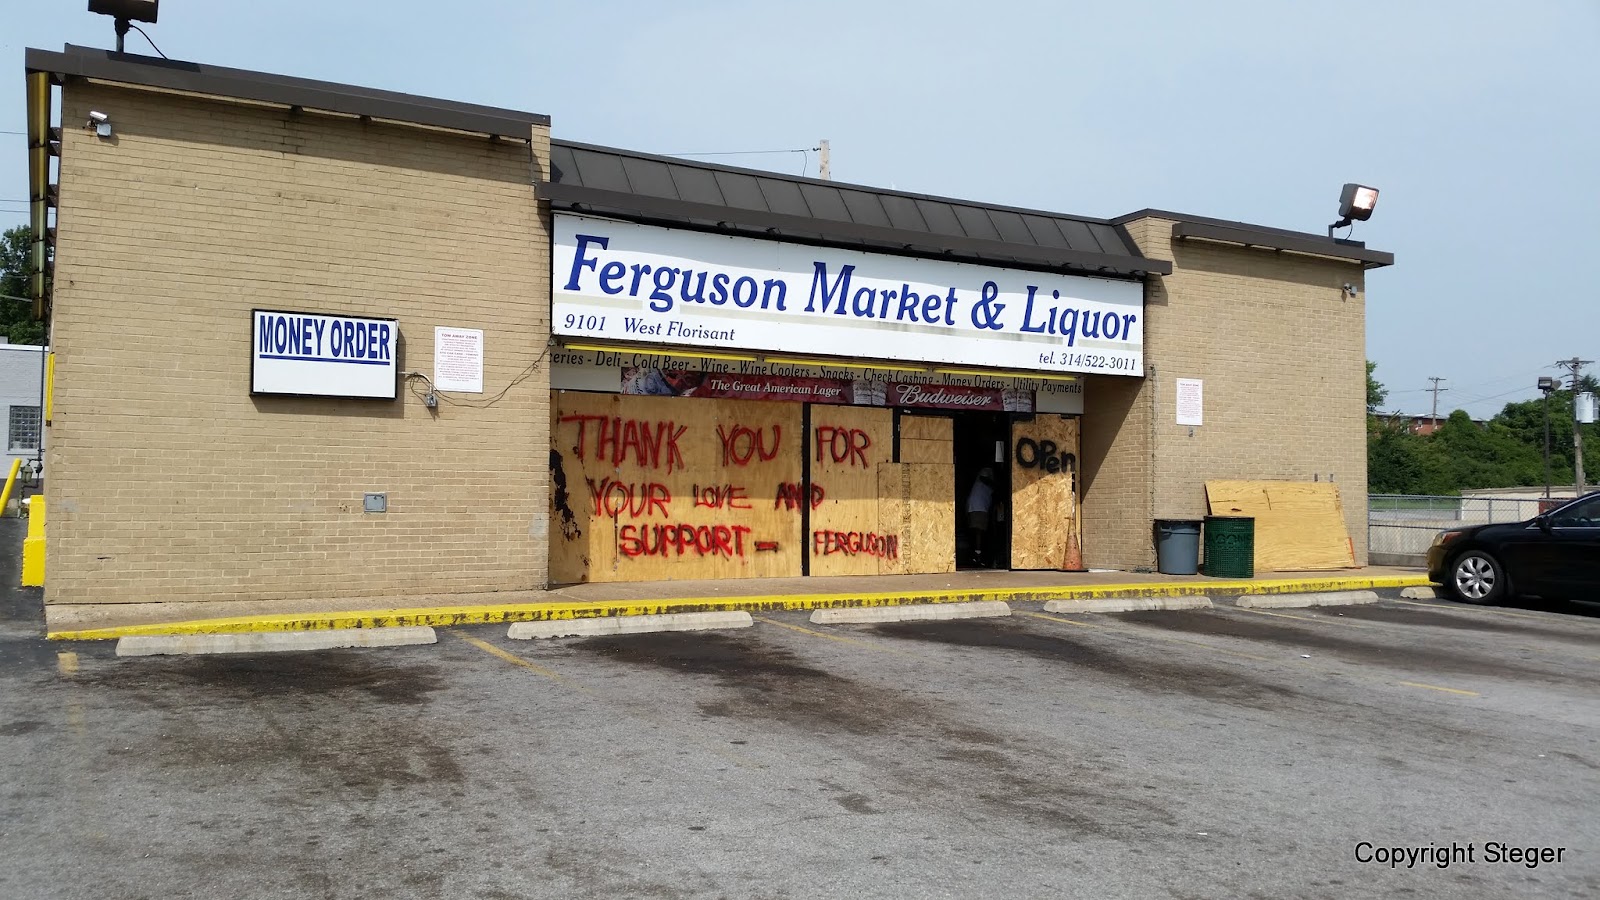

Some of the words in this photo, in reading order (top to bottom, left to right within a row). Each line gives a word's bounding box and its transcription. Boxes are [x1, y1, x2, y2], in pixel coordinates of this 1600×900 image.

[564, 234, 786, 312] Ferguson
[804, 261, 957, 326] Market
[971, 281, 1005, 331] &
[1020, 285, 1137, 347] Liquor
[260, 315, 326, 356] MONEY
[330, 320, 390, 359] ORDER
[564, 314, 606, 331] 9101
[624, 317, 661, 336] West
[666, 321, 735, 341] Florisant
[595, 350, 621, 367] Deli
[633, 353, 660, 370] Cold
[662, 355, 690, 371] Beer
[700, 357, 729, 373] Wine
[740, 359, 767, 375] Wine
[770, 362, 810, 377] Coolers
[820, 365, 854, 380] Snacks
[863, 367, 892, 382] Check
[942, 373, 972, 387] Money
[974, 375, 1005, 389] Orders
[1013, 377, 1039, 392] Utility
[1041, 379, 1081, 394] Payments
[1039, 352, 1056, 365] tel.
[1059, 353, 1136, 371] 314/522-3011
[711, 379, 730, 391] The
[732, 381, 761, 393] Great
[763, 383, 811, 395] American
[813, 385, 842, 397] Lager
[896, 384, 991, 406] Budweiser
[561, 415, 687, 474] THANK
[716, 424, 780, 467] YOU
[815, 426, 870, 469] FOR
[587, 476, 671, 518] YOUR
[693, 483, 752, 510] LOVE
[619, 523, 751, 560] SUPPORT
[813, 530, 898, 561] FERGUSON
